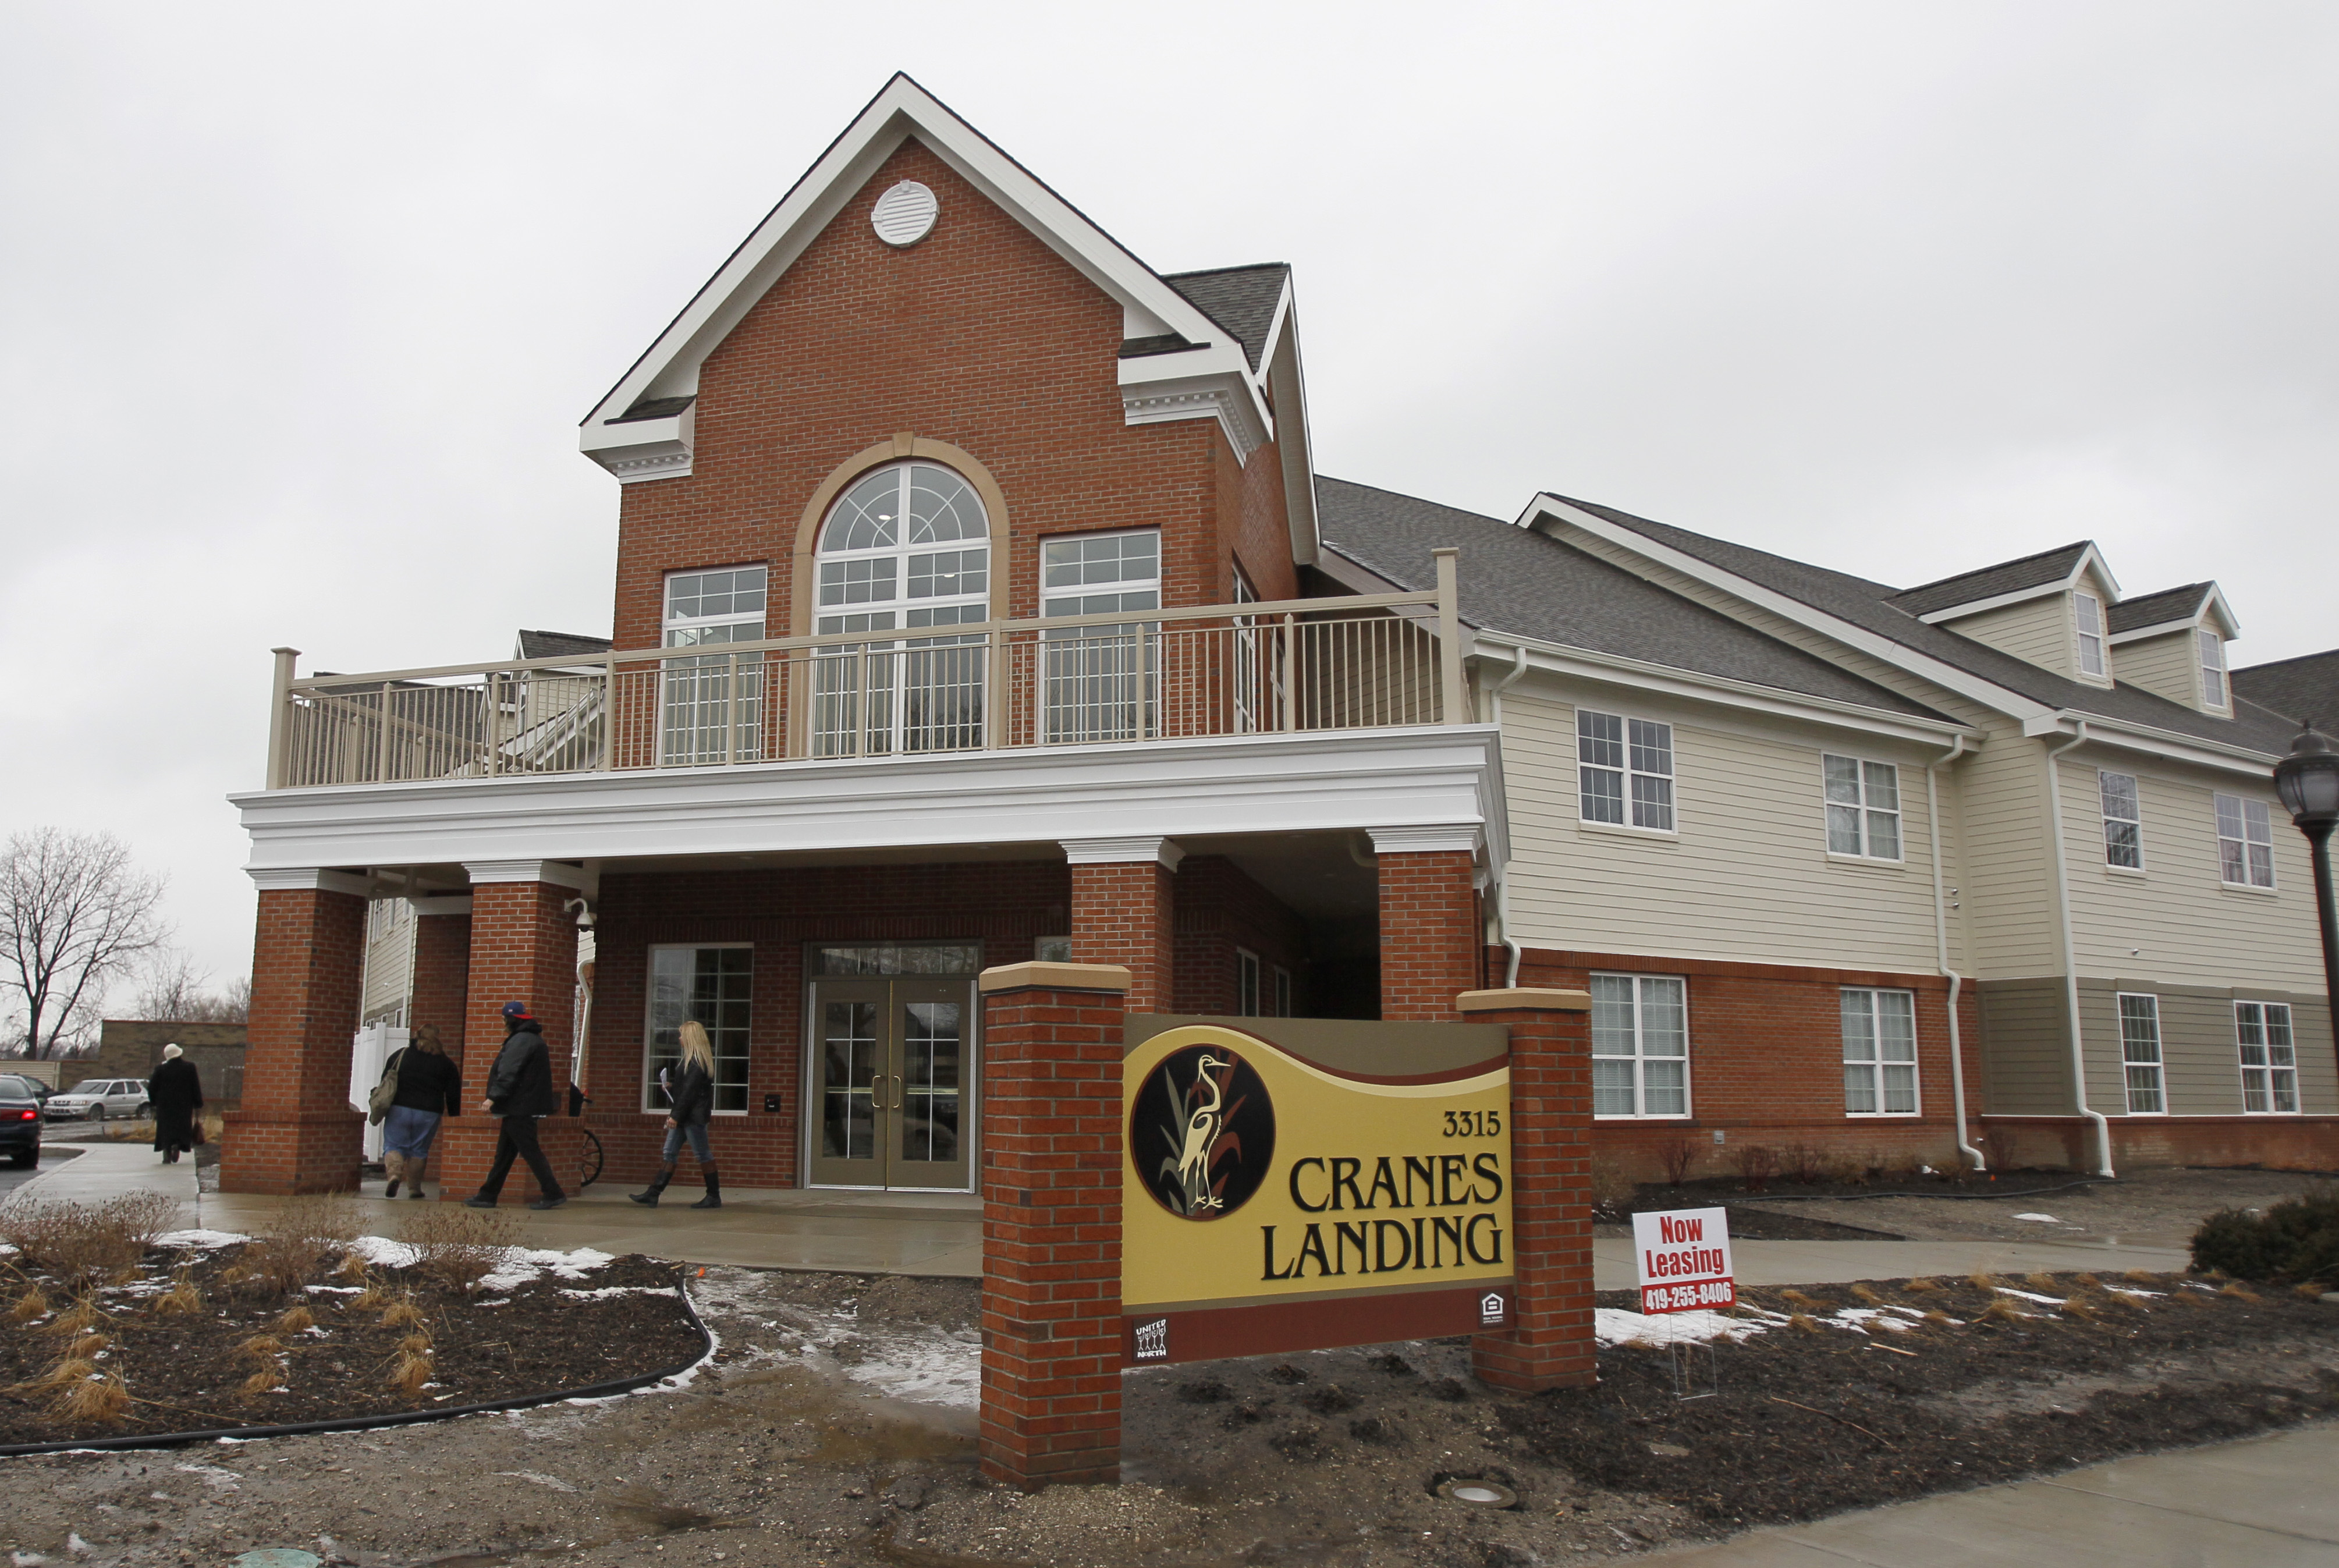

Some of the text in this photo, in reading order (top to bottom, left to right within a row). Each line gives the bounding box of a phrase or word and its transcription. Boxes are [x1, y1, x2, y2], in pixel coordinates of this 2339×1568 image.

[1443, 1111, 1501, 1137] 3315
[1290, 1153, 1503, 1212] CRANES
[1660, 1216, 1703, 1244] Now
[1261, 1213, 1503, 1280] LANDING
[1646, 1246, 1724, 1278] Leasing
[1646, 1282, 1732, 1310] 419-255-8406
[1136, 1319, 1166, 1335] UNITED
[1137, 1349, 1166, 1357] NORTH
